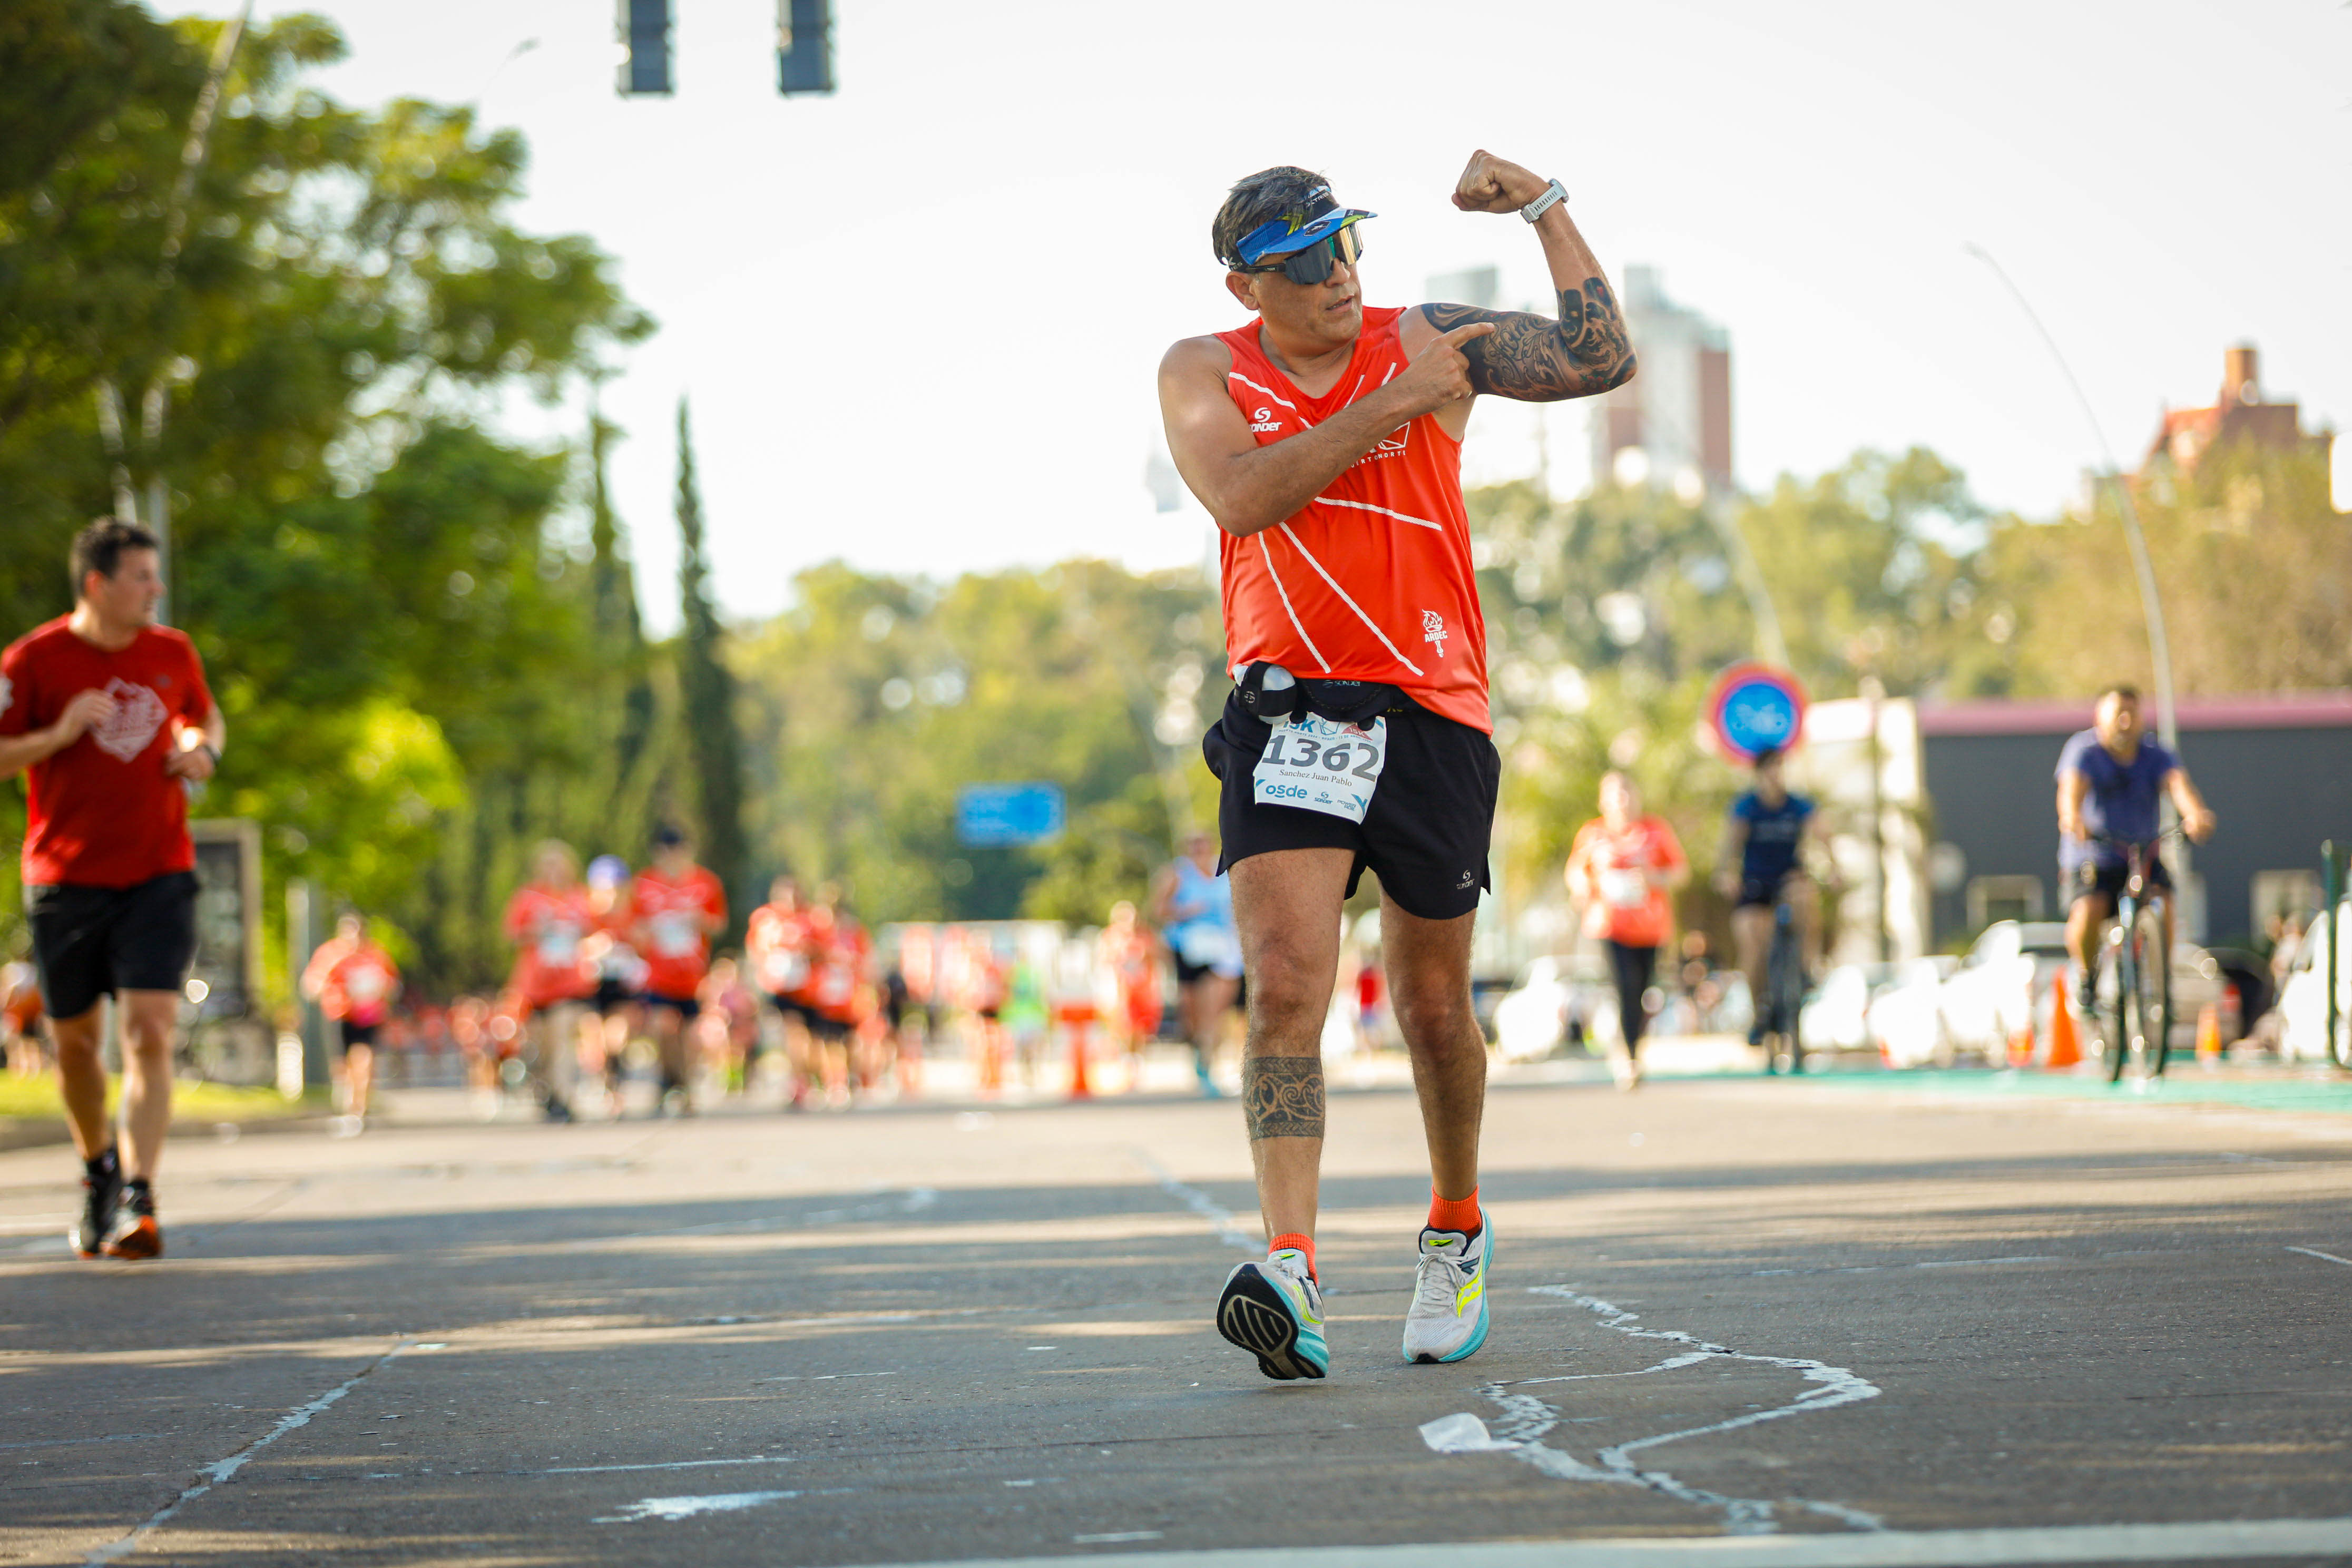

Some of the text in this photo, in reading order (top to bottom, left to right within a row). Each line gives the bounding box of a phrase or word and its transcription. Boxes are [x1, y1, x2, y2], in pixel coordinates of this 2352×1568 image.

[1424, 630, 1448, 642] ARDEC
[1349, 727, 1366, 738] 15K
[1262, 735, 1379, 782] 1362
[1279, 769, 1353, 787] Sanchez Juan Pablo
[1266, 784, 1307, 799] osde
